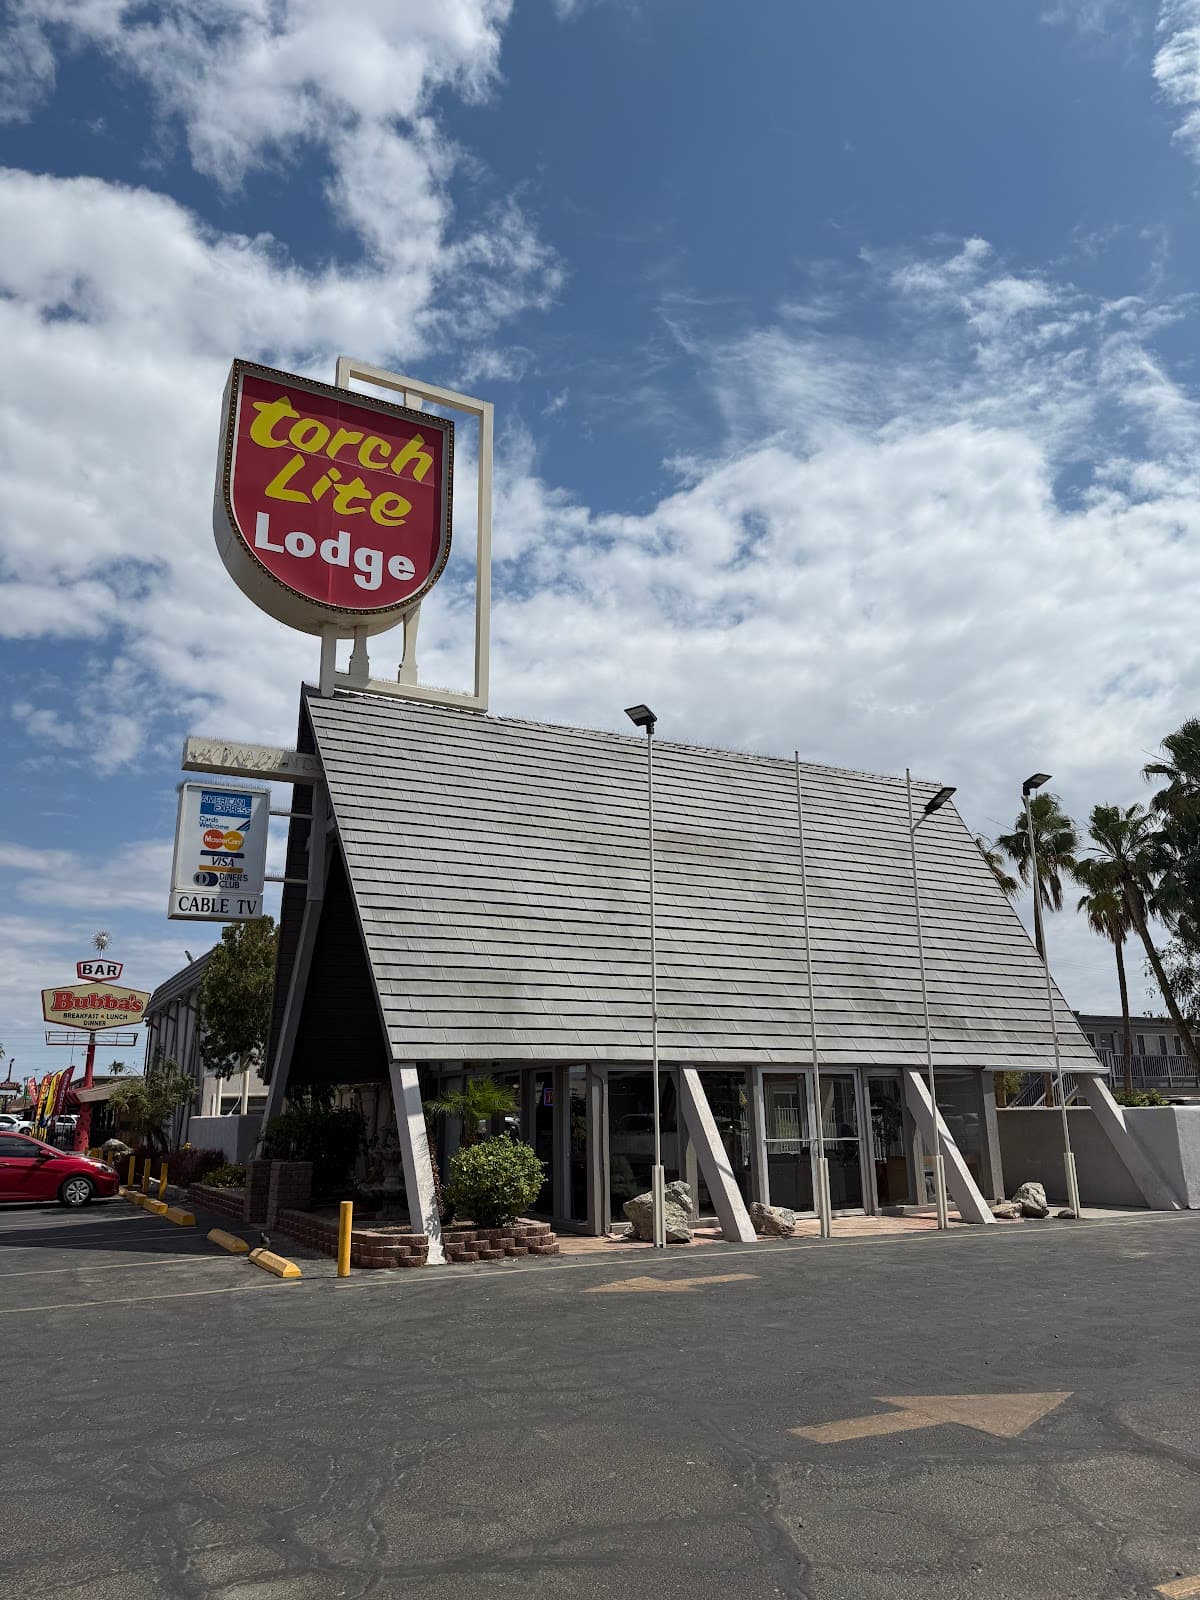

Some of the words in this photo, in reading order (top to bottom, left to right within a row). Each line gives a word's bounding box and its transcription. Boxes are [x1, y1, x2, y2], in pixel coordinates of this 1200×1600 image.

[250, 395, 433, 482] torch
[264, 453, 412, 527] Lite
[254, 511, 416, 591] Lodge
[201, 795, 246, 807] AMERICAN
[214, 805, 252, 815] EXPRESS
[200, 815, 219, 823] Cards
[200, 821, 230, 829] Welcome
[204, 835, 243, 846] MasterCard
[211, 856, 235, 867] VISA
[218, 880, 240, 889] CLUB
[178, 896, 229, 914] CABLE
[236, 900, 257, 915] TV
[82, 964, 117, 976] BAR
[51, 991, 143, 1012] Bubba's
